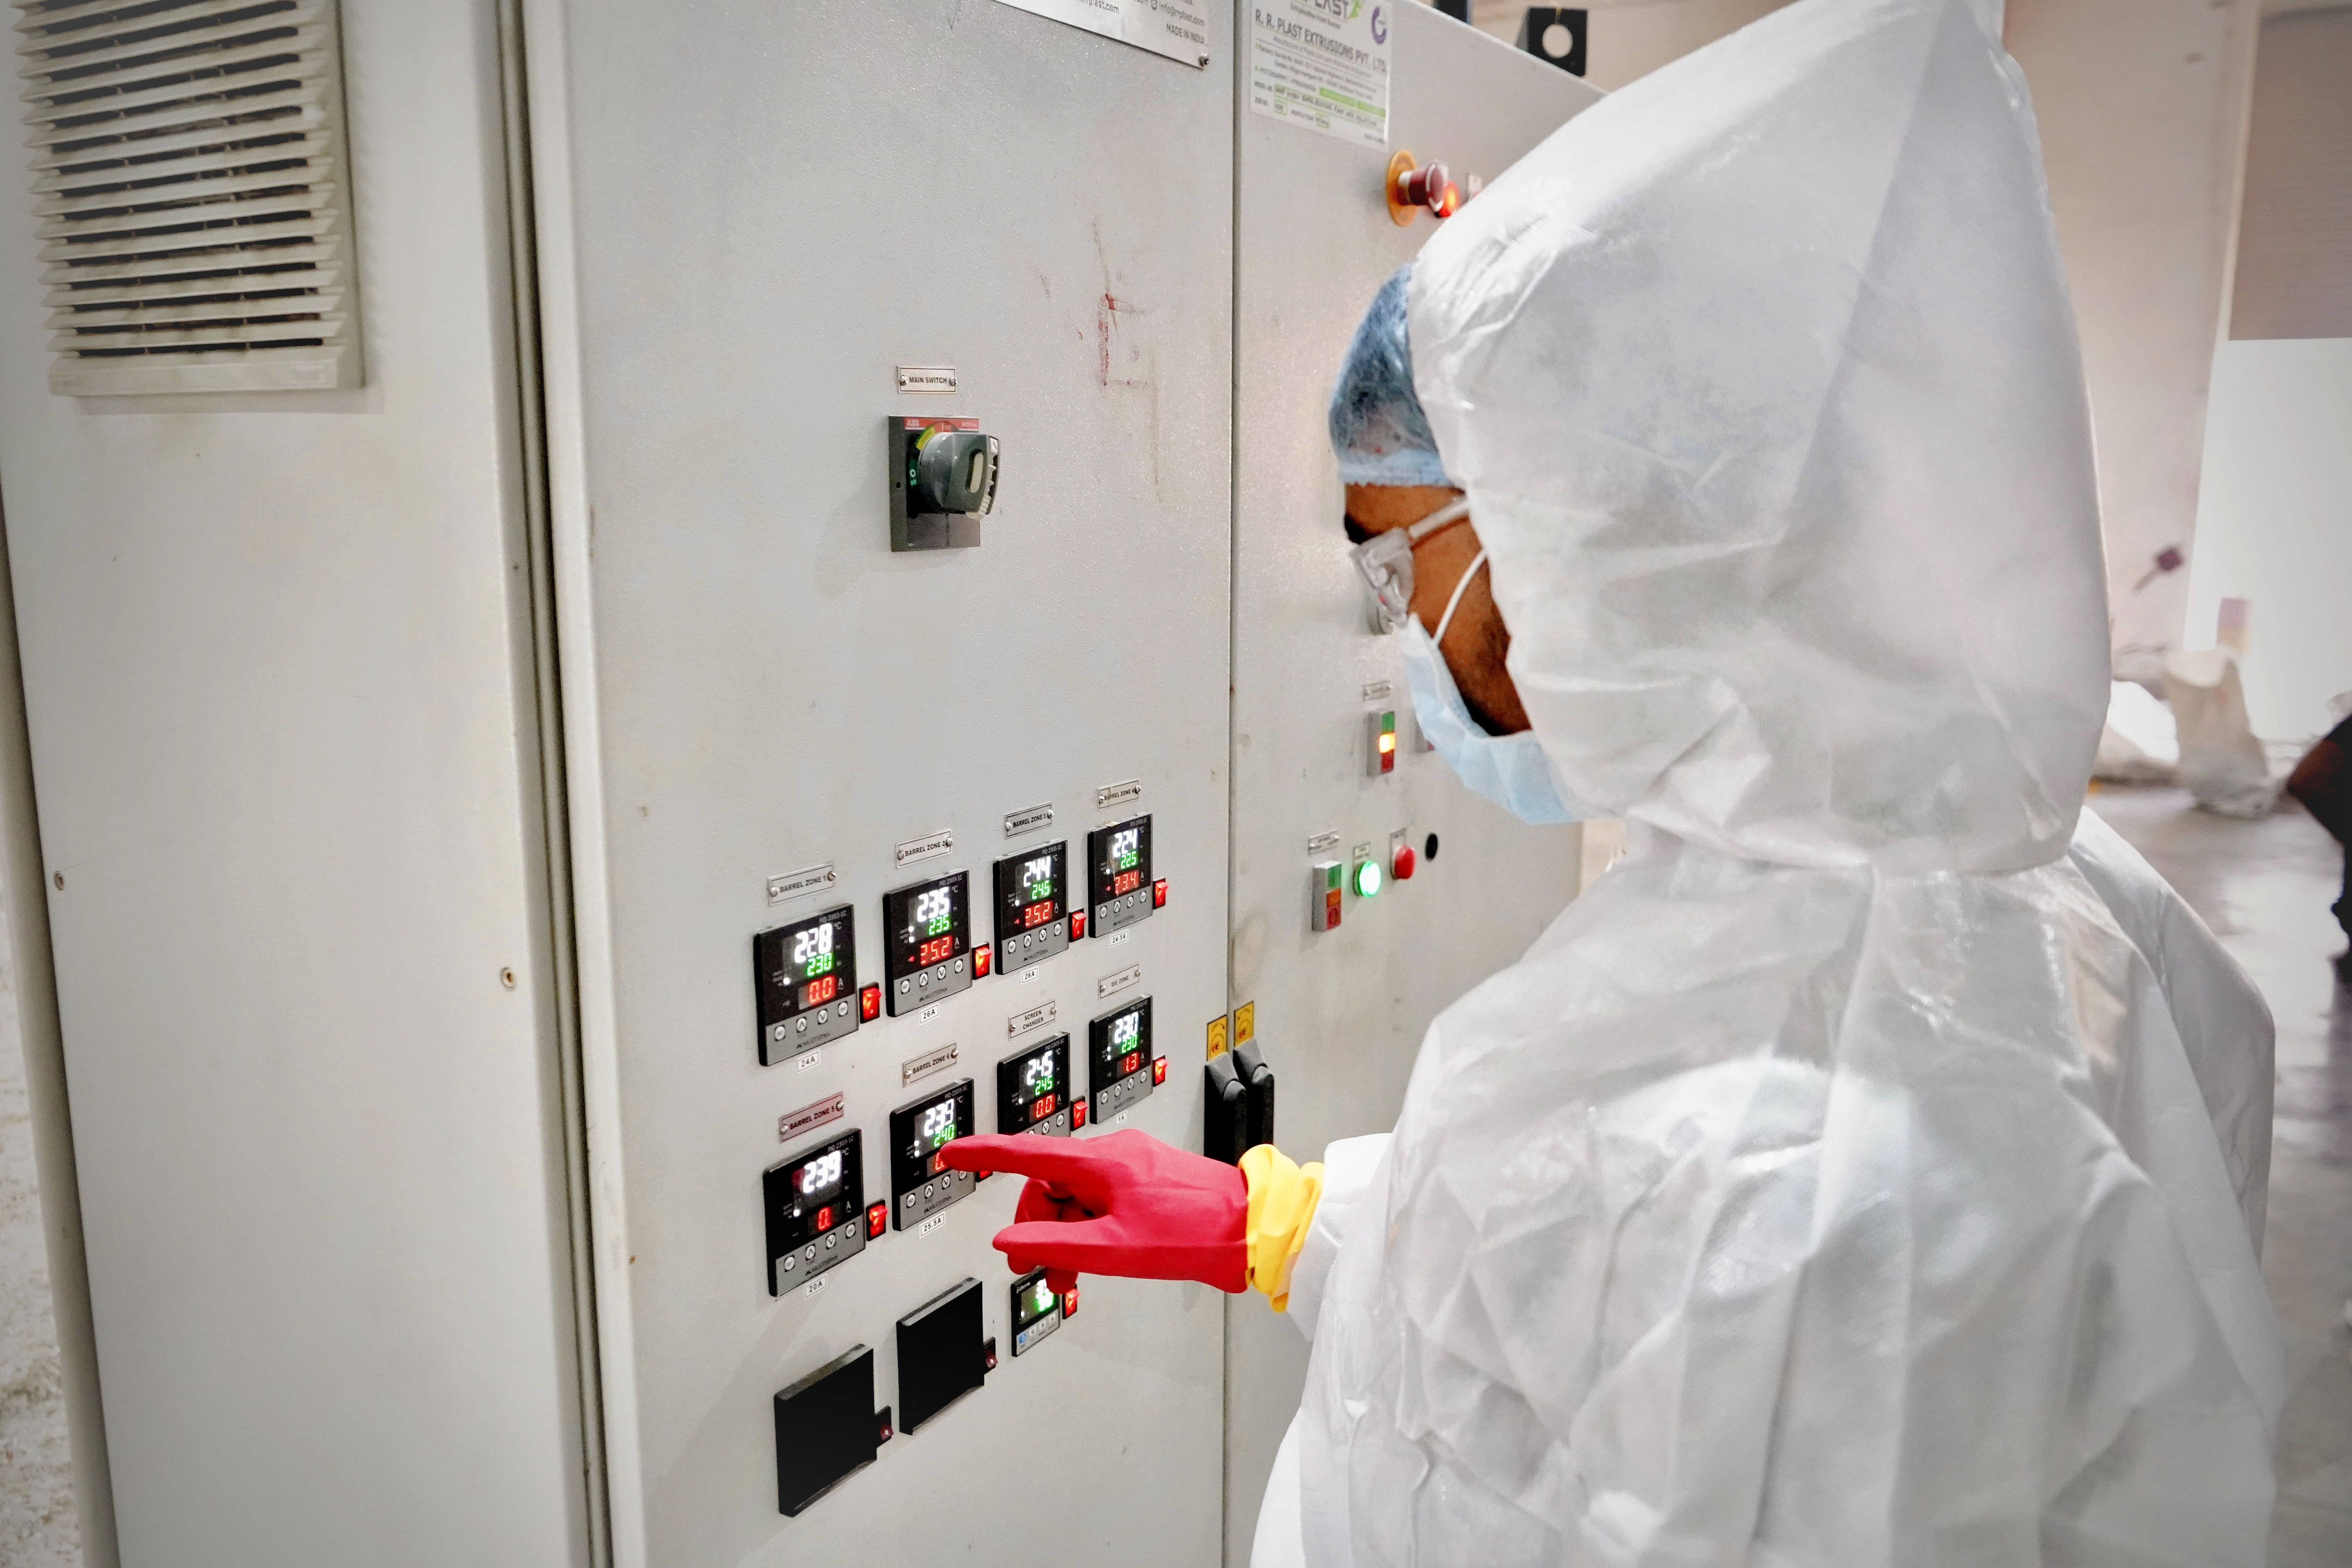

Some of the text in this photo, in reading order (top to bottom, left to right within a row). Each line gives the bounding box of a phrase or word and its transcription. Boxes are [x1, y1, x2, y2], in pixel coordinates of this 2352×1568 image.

[1167, 23, 1182, 37] MADE
[1183, 29, 1189, 39] IN
[1278, 18, 1302, 39] PLAST
[1105, 792, 1119, 800] BARREL
[1013, 818, 1030, 828] BARREL
[905, 846, 926, 856] BARREL
[927, 842, 940, 850] ZONE
[1114, 828, 1137, 857] 224
[1121, 851, 1136, 869] 225
[1024, 856, 1051, 887] 244
[780, 882, 803, 893] BARREL
[806, 877, 822, 886] ZONE
[1032, 880, 1049, 900] 245
[917, 886, 949, 922] 235
[929, 914, 949, 935] 235
[795, 923, 832, 963] 228
[1112, 933, 1126, 943] 24.5A
[807, 953, 832, 976] 230
[1025, 971, 1035, 980] 26A
[1119, 975, 1129, 984] ZONE
[923, 1009, 935, 1019] 26A
[1023, 1017, 1044, 1029] CHANGER
[1025, 1010, 1042, 1021] SCREEN
[1114, 1012, 1138, 1044] 230
[1122, 1034, 1137, 1053] 230
[801, 1056, 815, 1067] 24A
[913, 1062, 931, 1074] BARREL
[933, 1055, 946, 1065] ZONE
[1027, 1050, 1053, 1085] 245
[1035, 1074, 1052, 1096] 245
[1036, 1095, 1053, 1118] 0.0
[790, 1116, 812, 1130] BARREL
[814, 1108, 830, 1120] ZONE
[924, 1099, 954, 1136] 239
[934, 1124, 954, 1147] 240
[803, 1151, 840, 1193] 239
[924, 1218, 941, 1231] 25.5A
[809, 1281, 822, 1293] 20A
